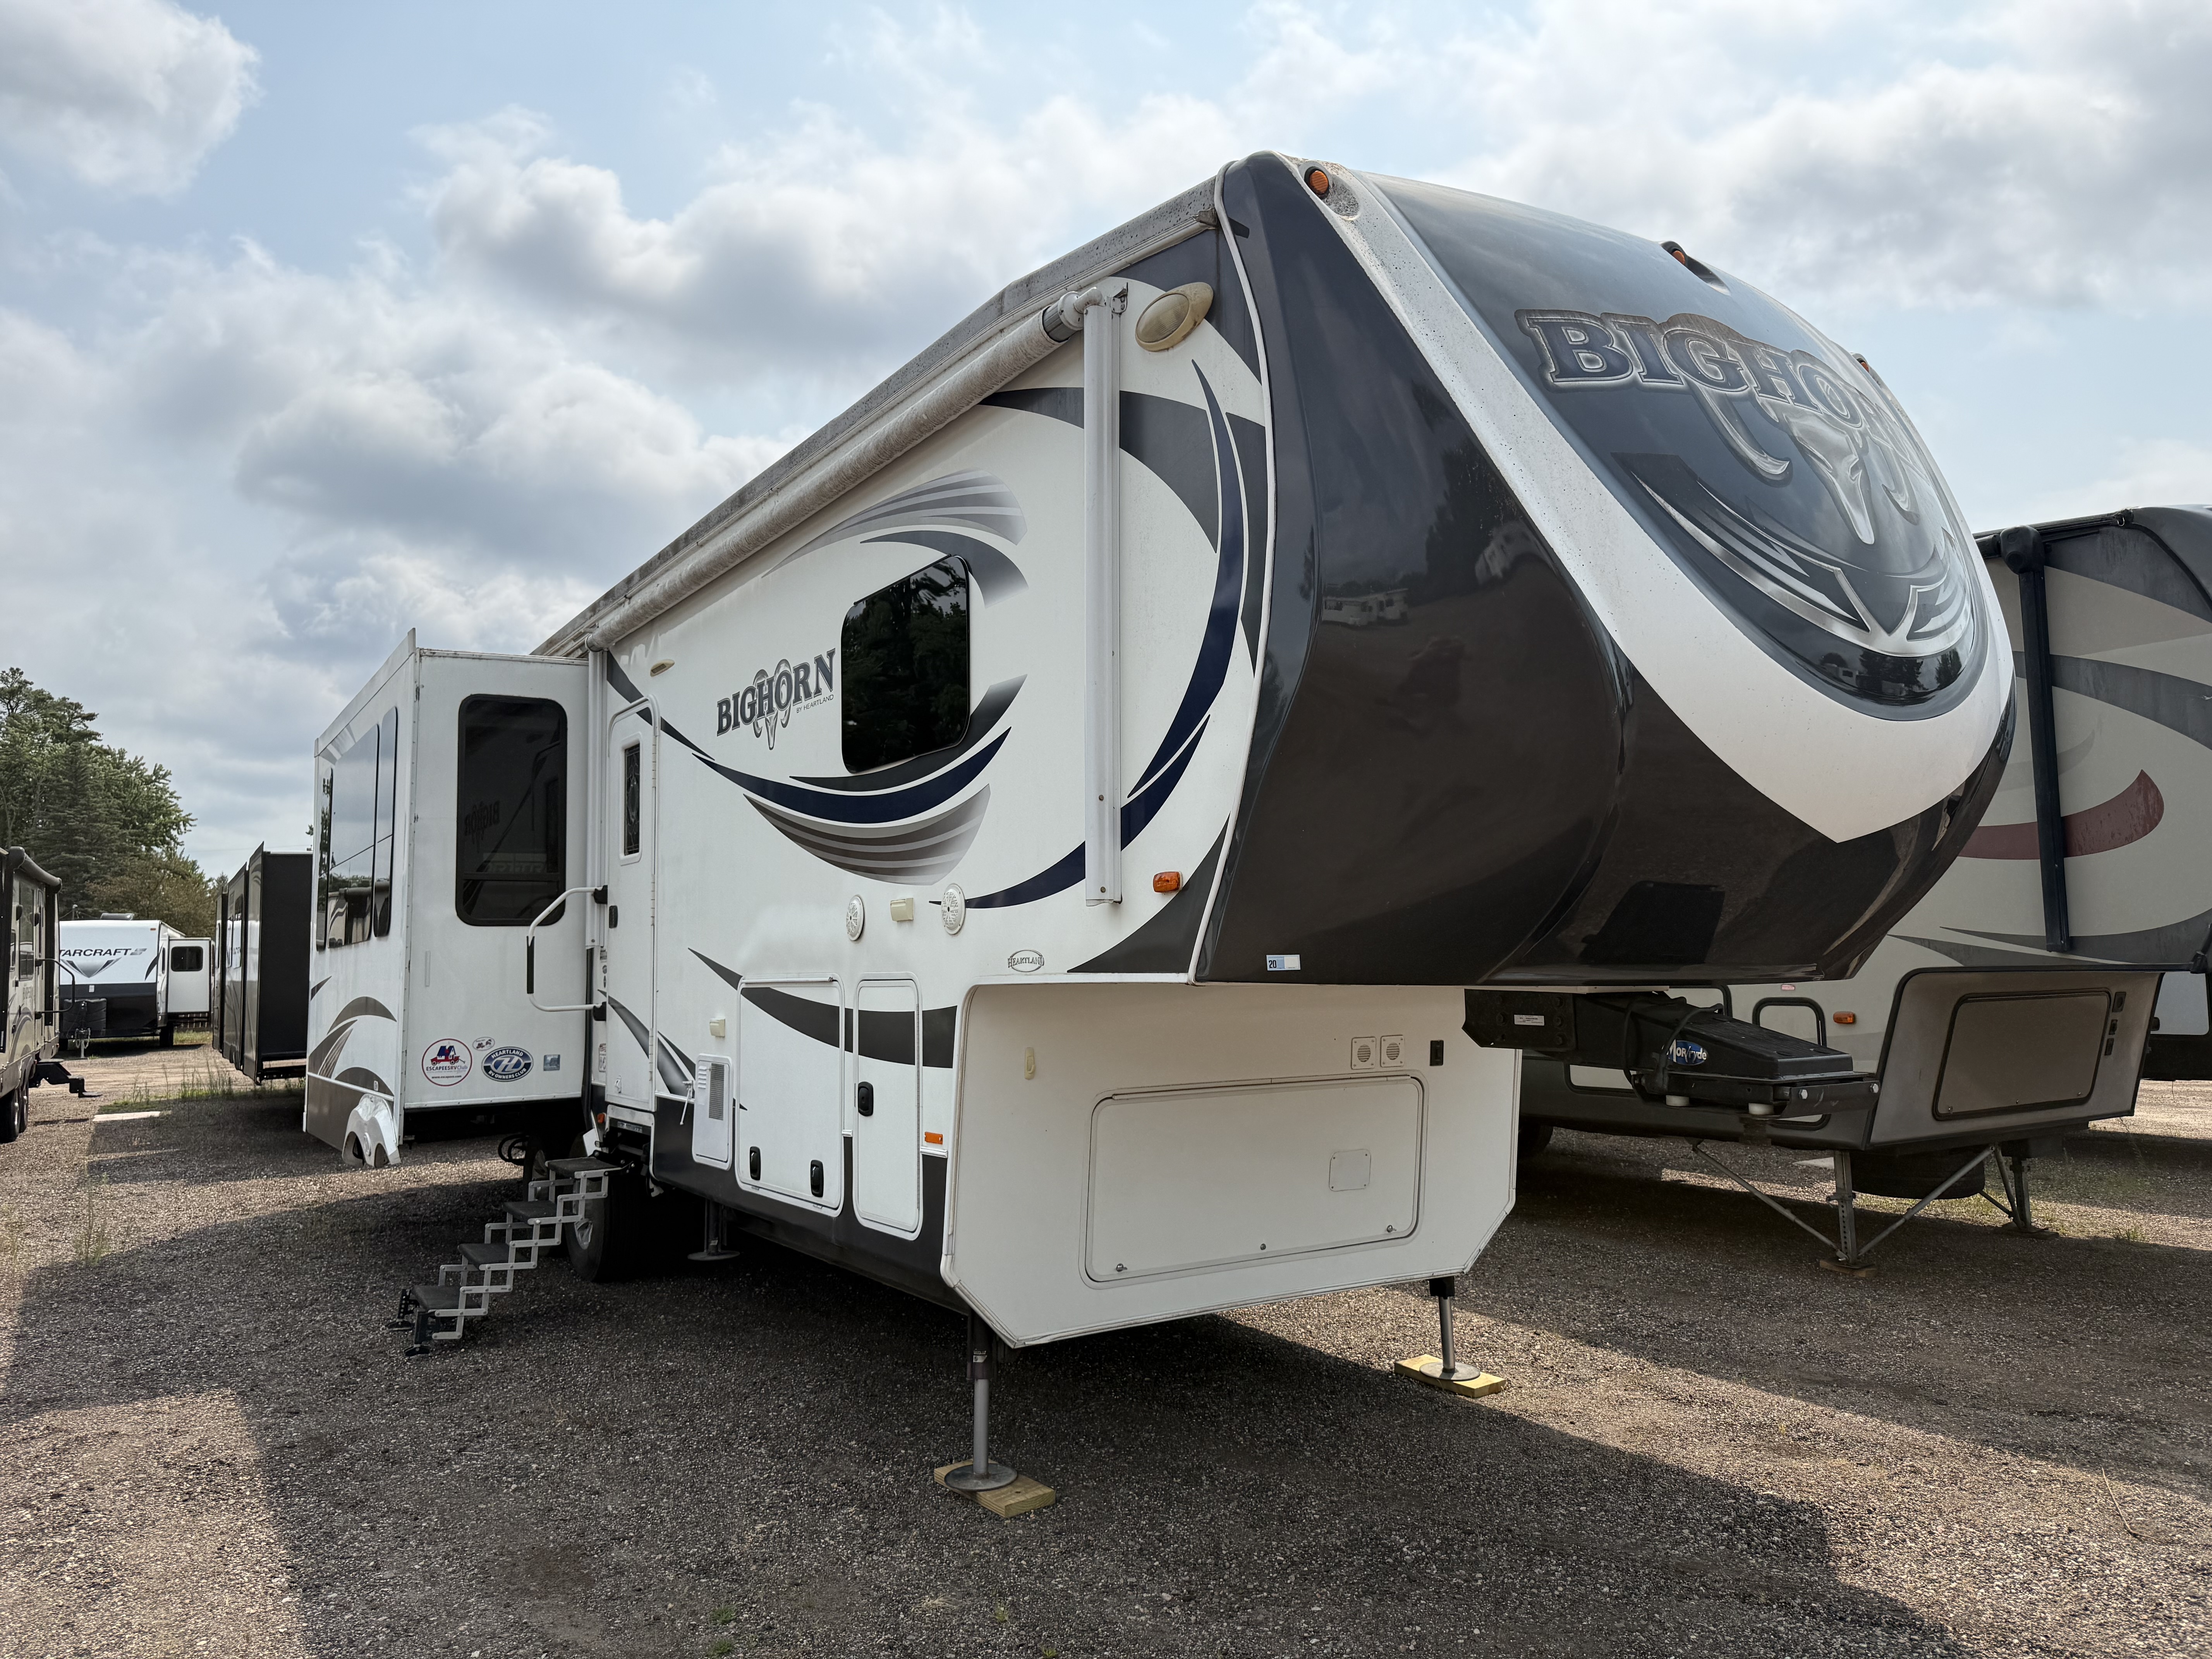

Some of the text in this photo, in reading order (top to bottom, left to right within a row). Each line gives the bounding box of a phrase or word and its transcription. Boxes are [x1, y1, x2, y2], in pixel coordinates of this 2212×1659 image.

[717, 647, 835, 737] BIGHORN
[804, 694, 834, 710] HEARTLAND
[60, 948, 132, 957] TARCRAFT
[1269, 960, 1277, 968] 20
[491, 1049, 523, 1059] HEARTLAND
[515, 1068, 527, 1077] CLUB
